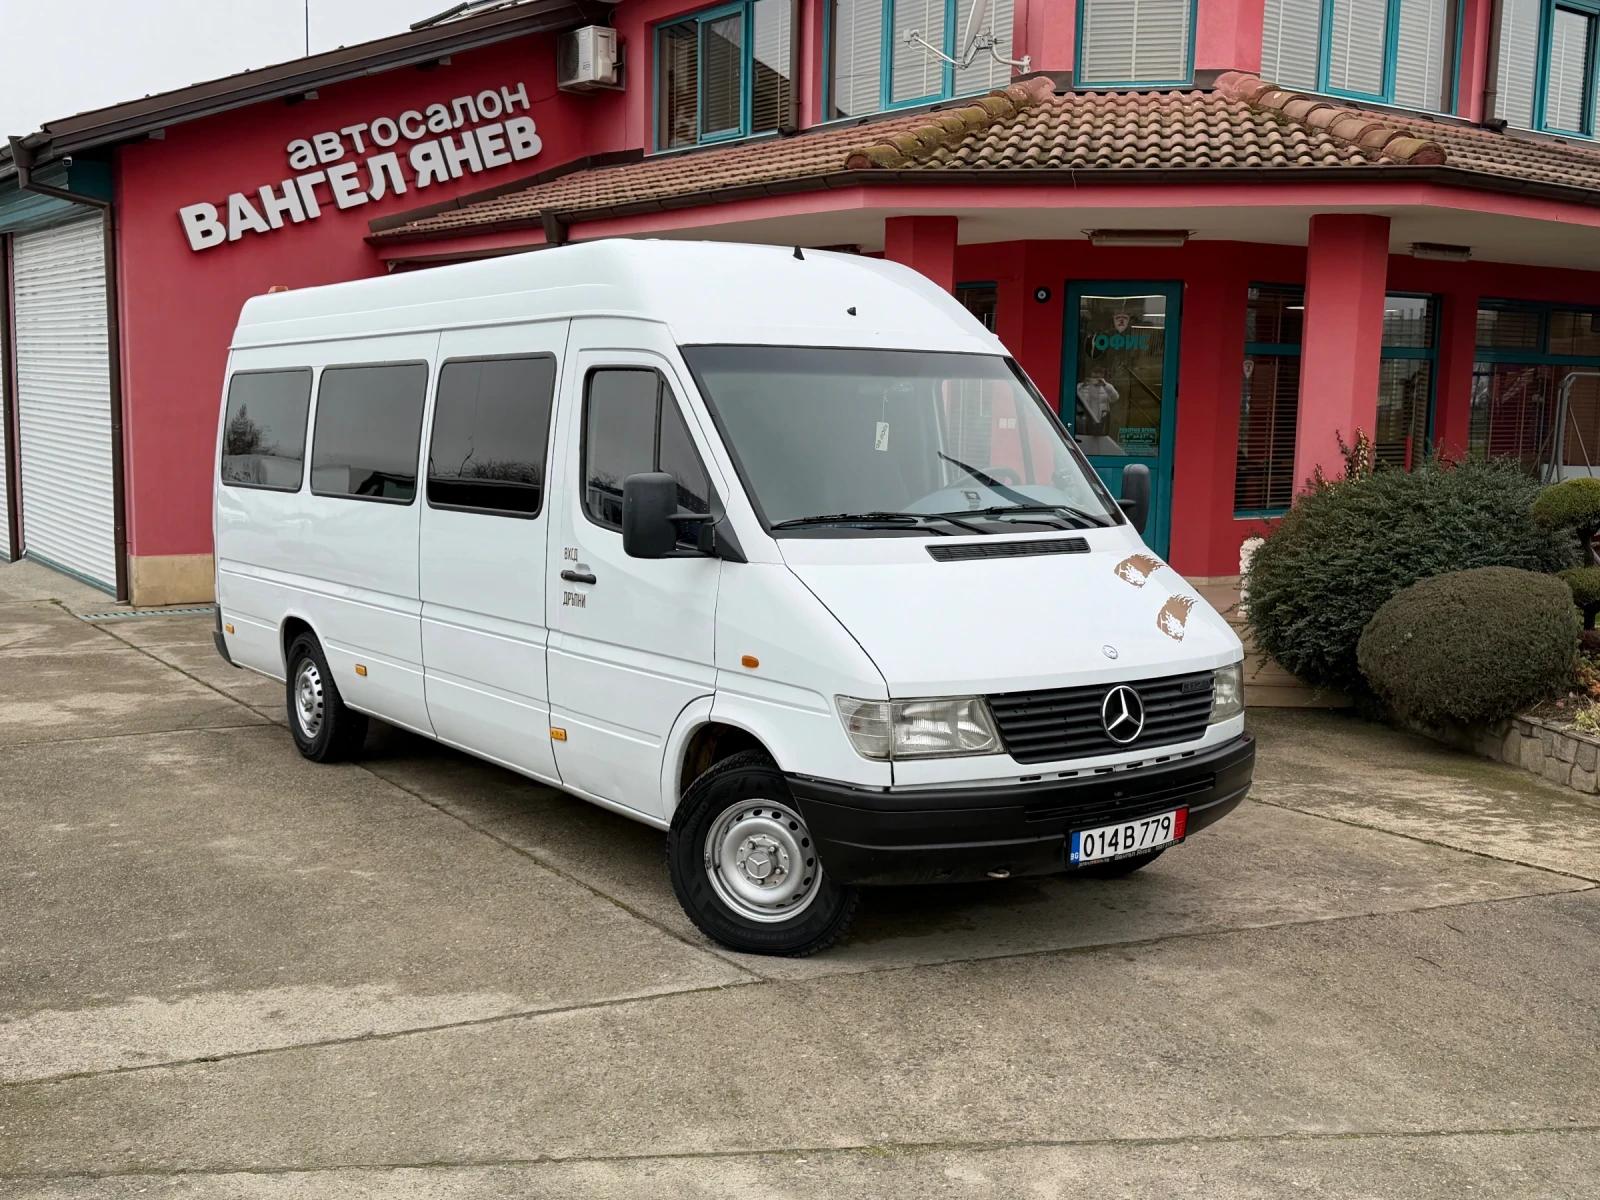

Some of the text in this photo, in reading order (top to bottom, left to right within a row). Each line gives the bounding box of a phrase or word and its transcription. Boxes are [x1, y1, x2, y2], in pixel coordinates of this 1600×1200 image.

[287, 82, 530, 170] автосалон
[179, 116, 542, 251] ВАНГЕЛ ЯНЕВ
[1094, 334, 1150, 351] ОФИС
[1070, 852, 1079, 861] BG
